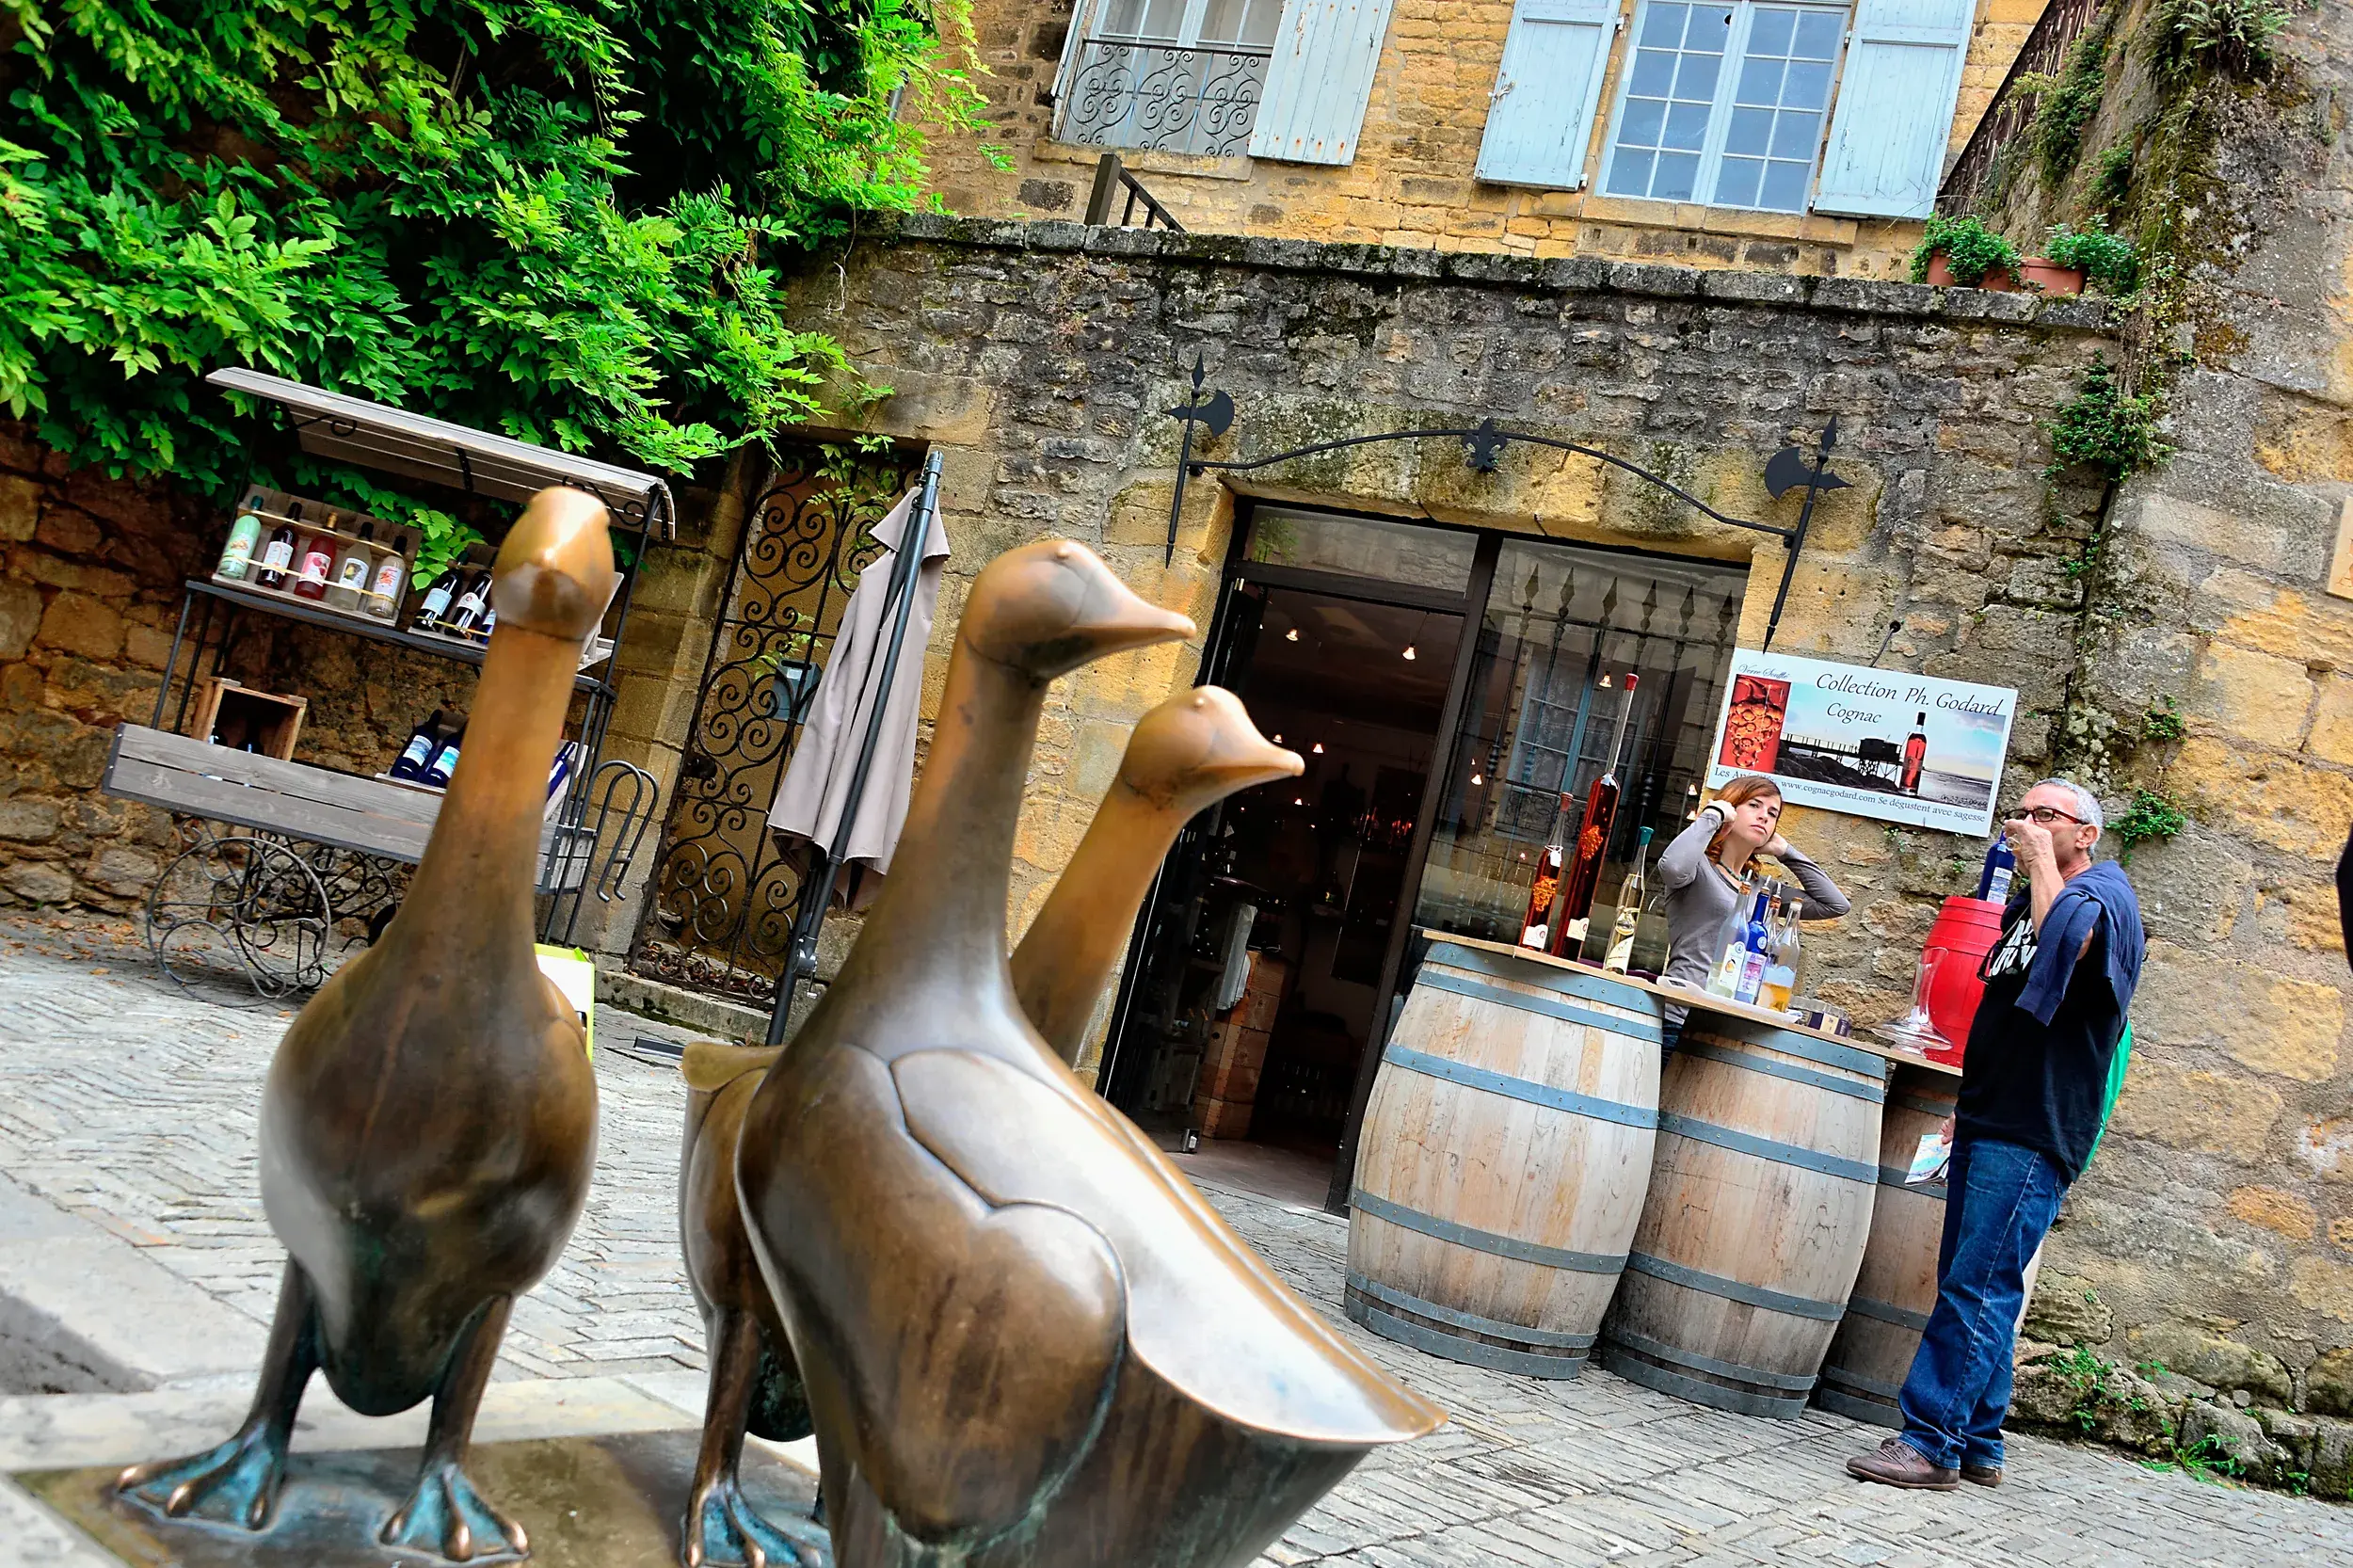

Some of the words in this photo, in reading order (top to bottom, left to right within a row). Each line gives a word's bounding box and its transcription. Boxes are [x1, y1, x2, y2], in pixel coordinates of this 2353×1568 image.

[1817, 673, 1897, 700] Collection
[1904, 687, 1929, 706] Ph.
[1936, 692, 2004, 716] Godard
[1827, 702, 1882, 725] Cognac
[1714, 767, 1731, 778] Les
[1781, 781, 1876, 804] www.cognacgodard.com
[1877, 796, 1888, 806] Se
[1889, 798, 1930, 813] dégustent
[1932, 808, 1953, 817] avec
[1953, 811, 1986, 823] sagesse
